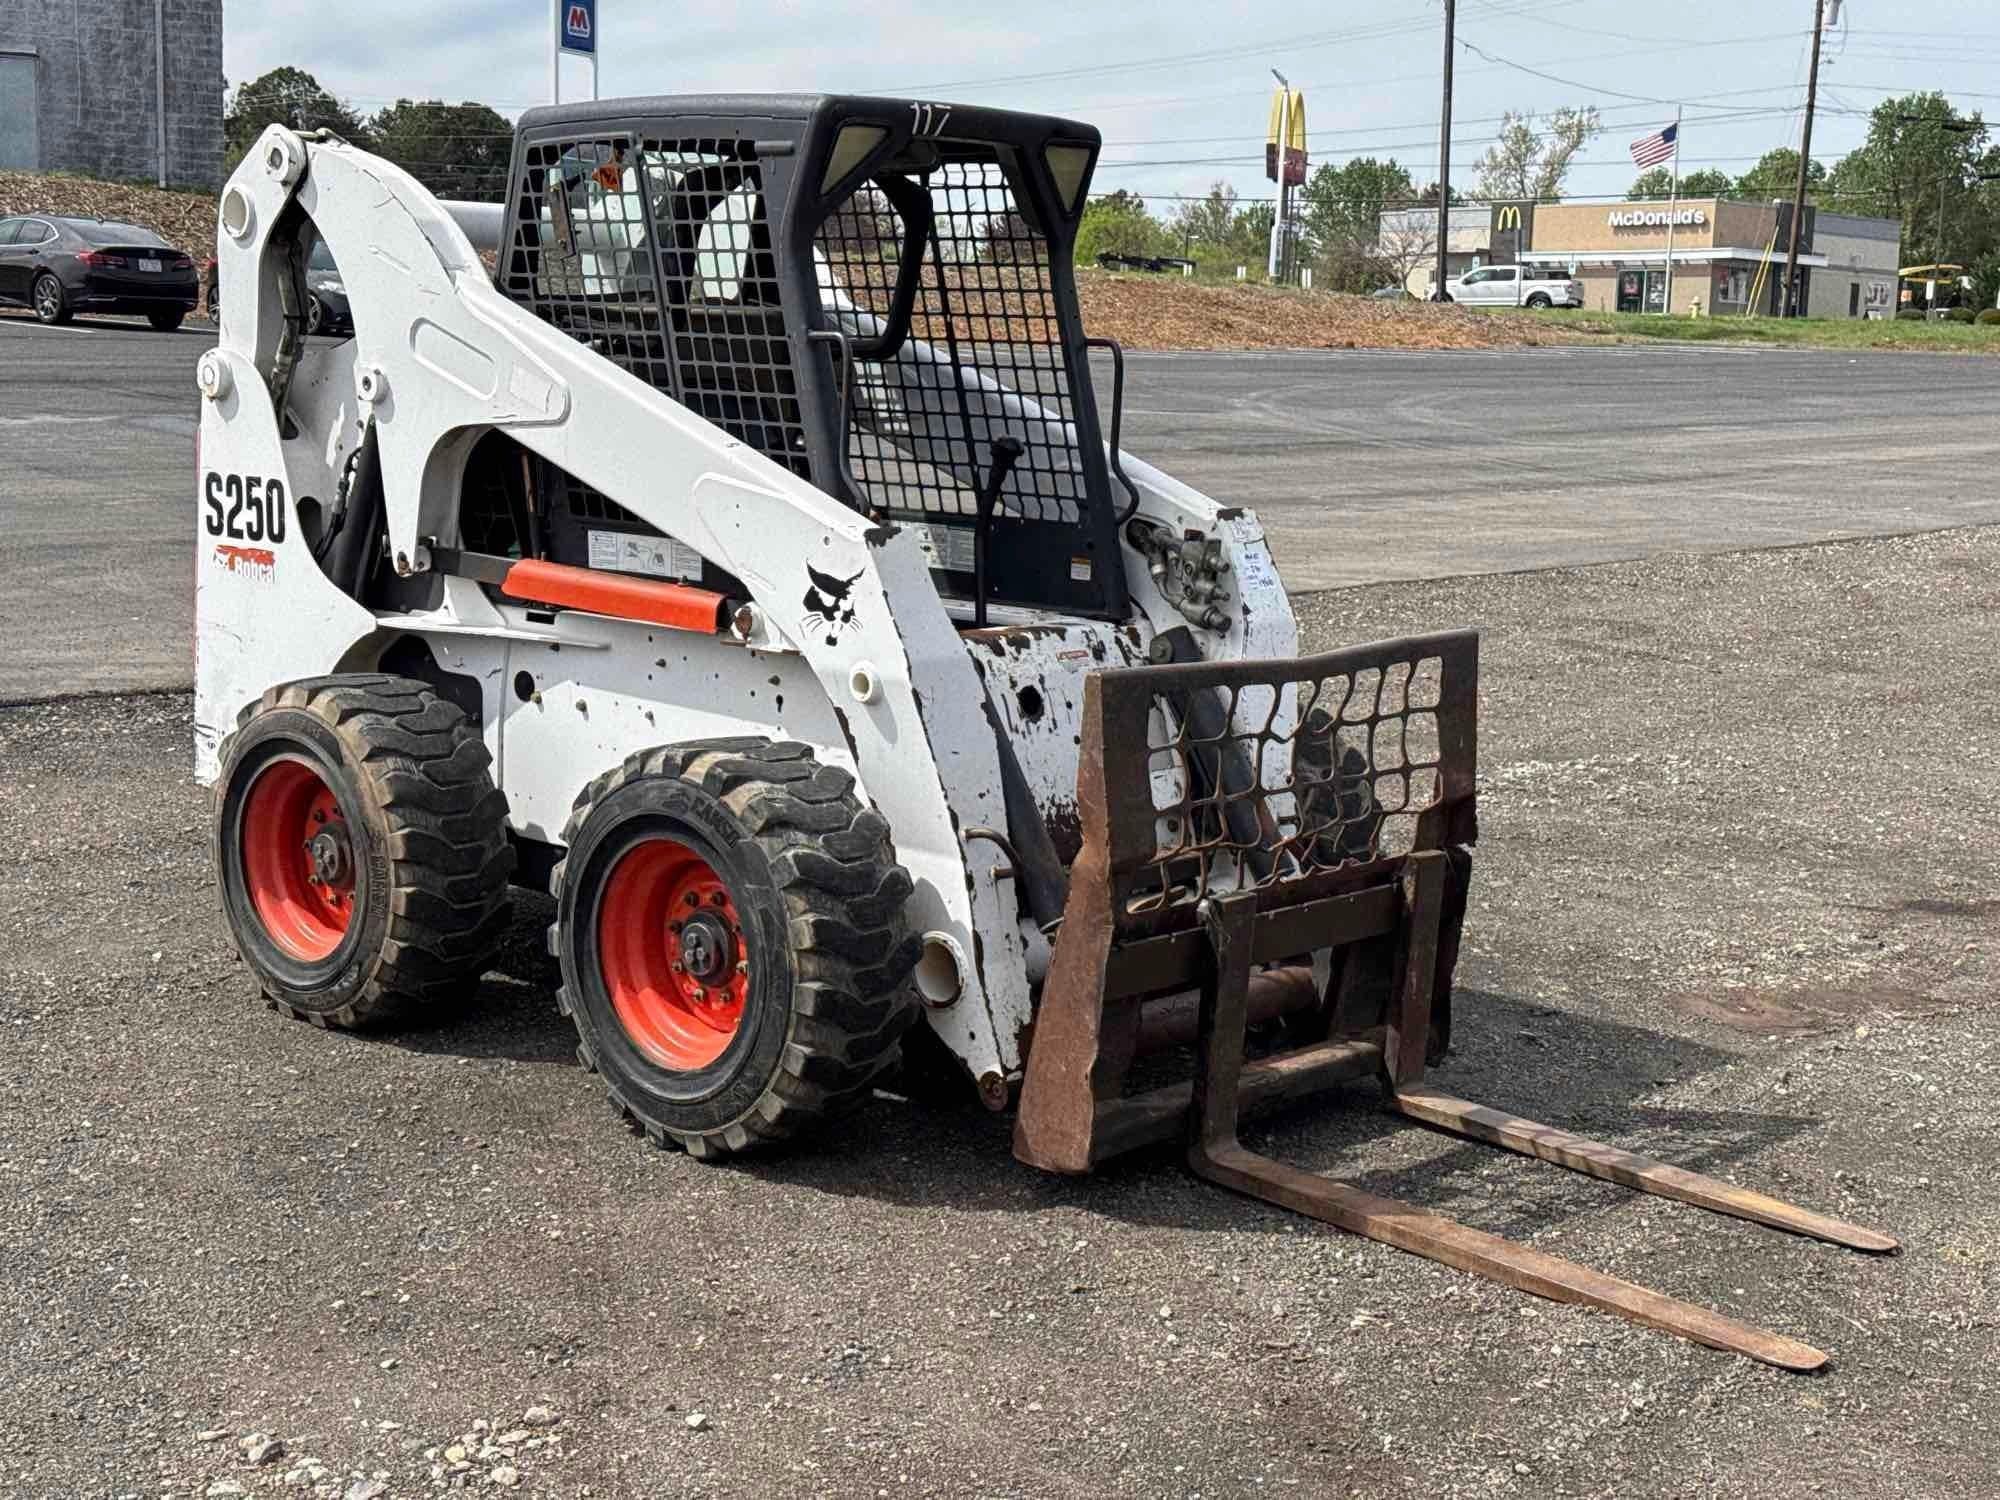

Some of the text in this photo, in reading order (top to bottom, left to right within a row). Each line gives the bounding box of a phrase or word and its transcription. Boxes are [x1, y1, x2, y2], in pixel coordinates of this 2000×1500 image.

[909, 101, 953, 137] 117
[1608, 208, 1705, 227] McDonald's
[205, 472, 285, 545] S250
[234, 553, 278, 585] Bobca
